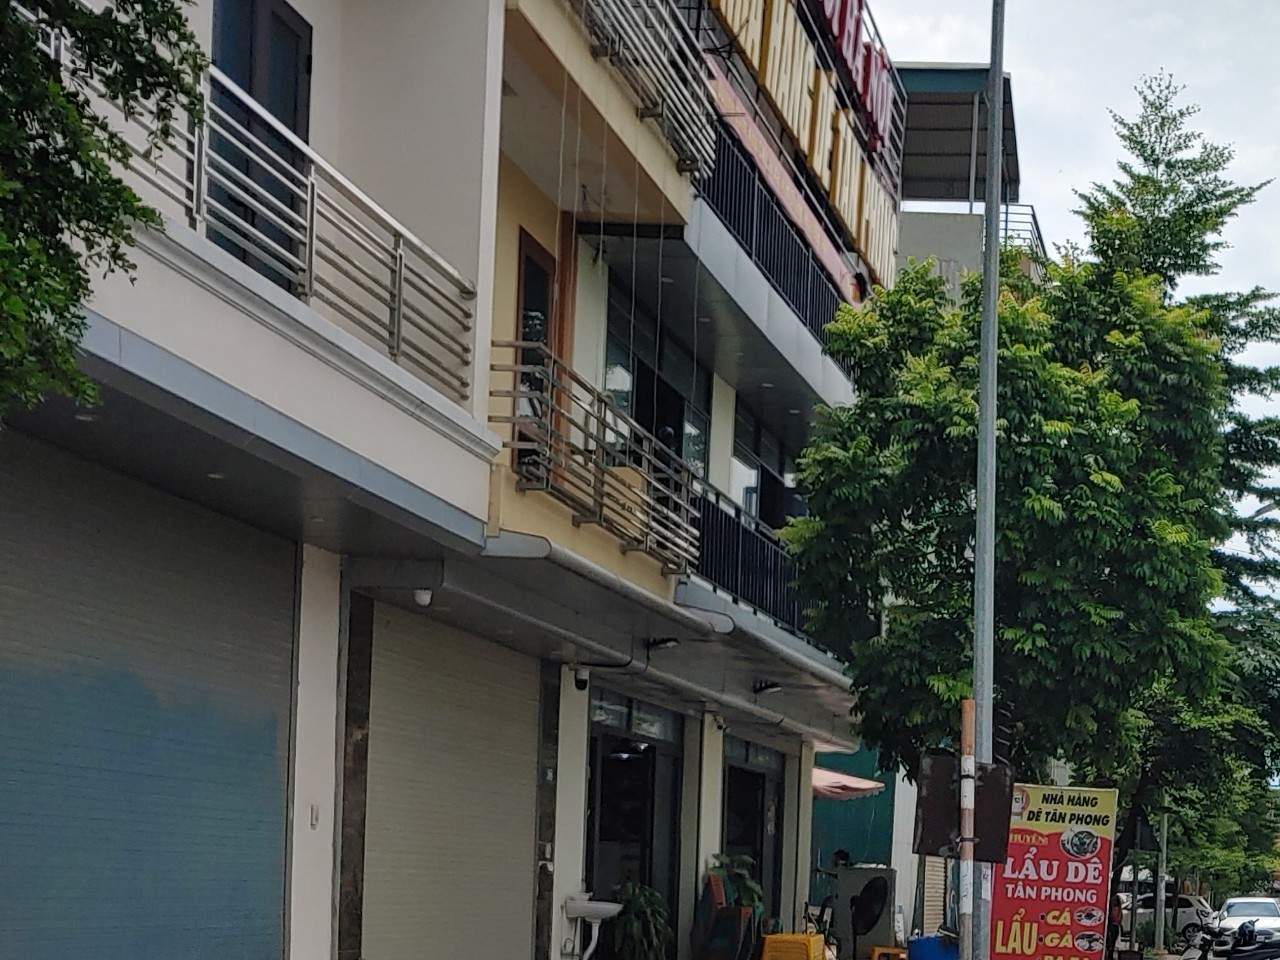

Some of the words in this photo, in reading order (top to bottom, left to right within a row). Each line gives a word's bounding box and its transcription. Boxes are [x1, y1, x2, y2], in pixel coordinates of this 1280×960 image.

[1041, 791, 1064, 806] NHÀ
[1067, 792, 1099, 808] HÀNG
[1027, 807, 1042, 822] DÊ
[1045, 808, 1067, 824] TÂN
[1069, 813, 1110, 826] PHONG
[1003, 847, 1060, 881] LẨU
[1066, 857, 1103, 885] DÊ
[1005, 881, 1038, 899] TÂN
[1041, 886, 1097, 904] PHONG
[1046, 907, 1071, 926] CÁ
[995, 908, 1039, 956] LẨU
